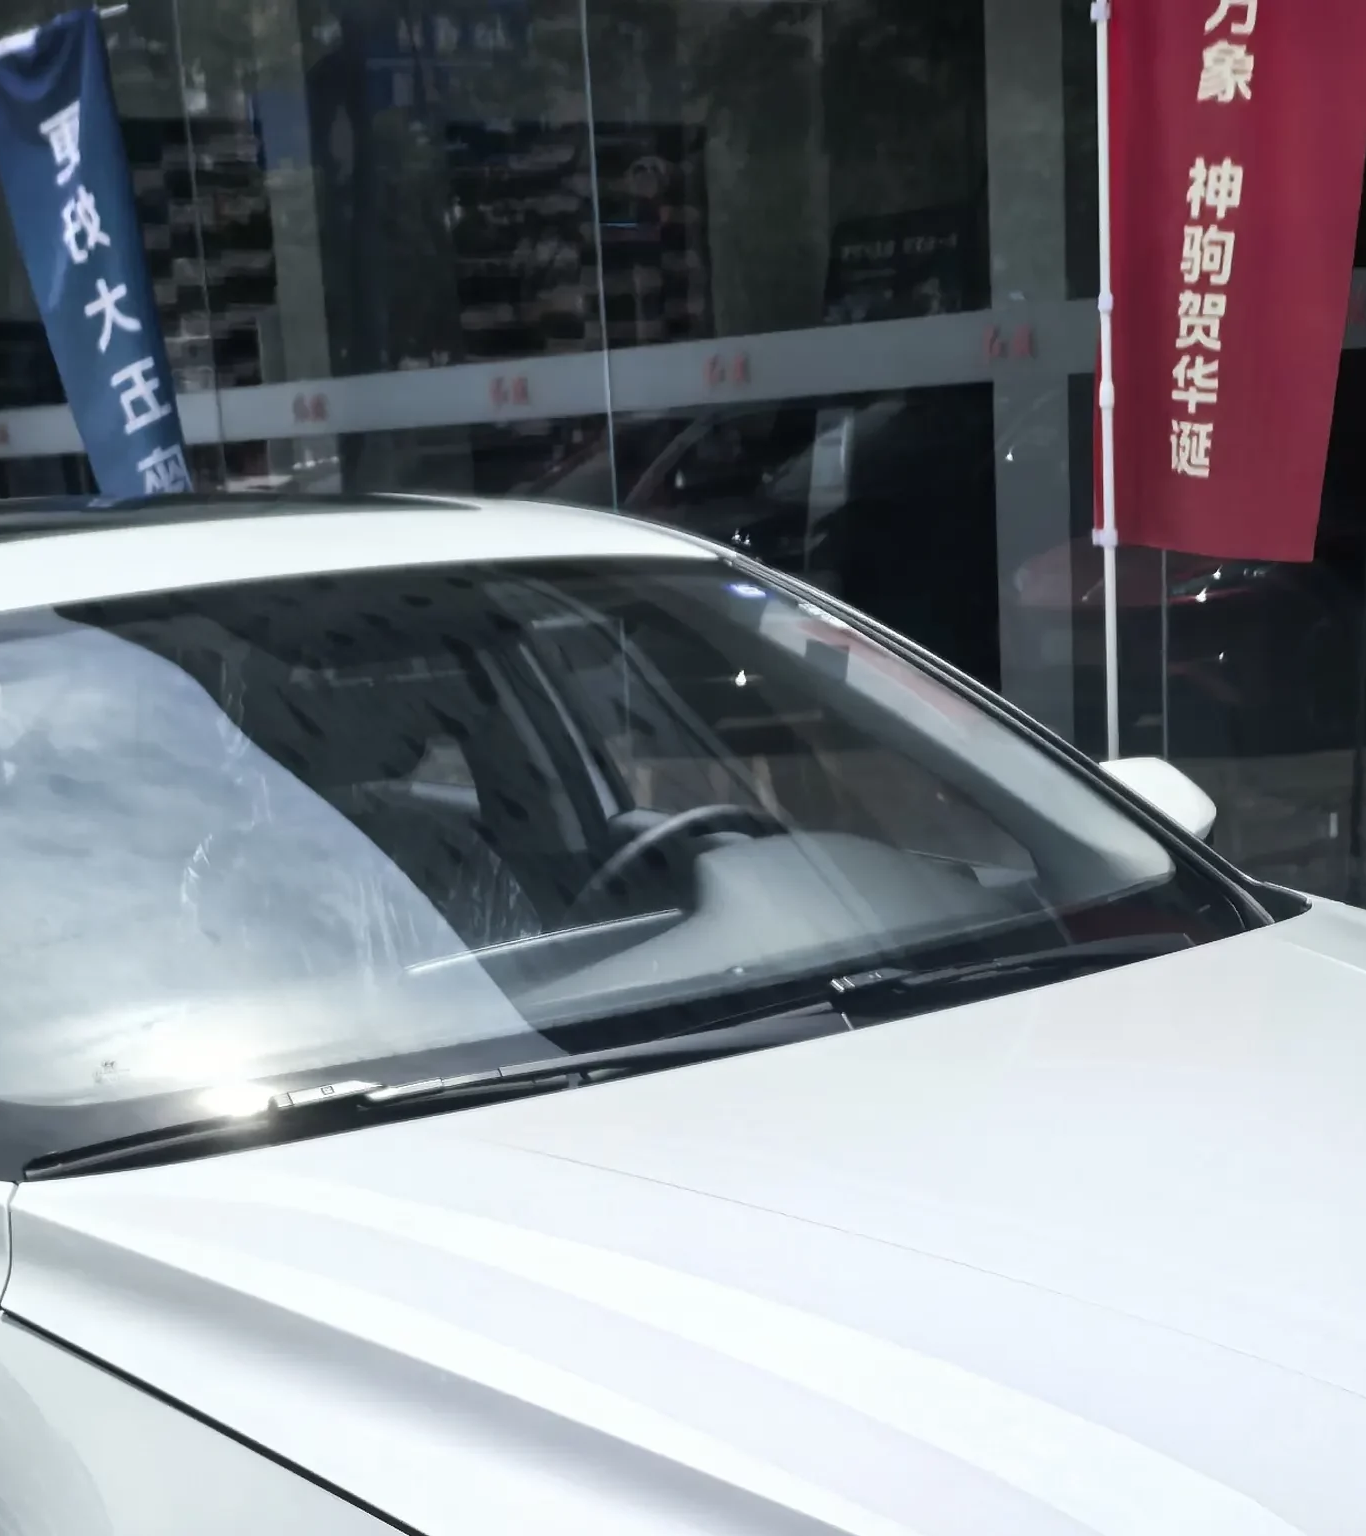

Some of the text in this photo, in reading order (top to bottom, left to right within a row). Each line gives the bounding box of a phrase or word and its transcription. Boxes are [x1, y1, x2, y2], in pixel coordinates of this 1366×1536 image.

[1169, 157, 1244, 479] 神驹贺华诞
